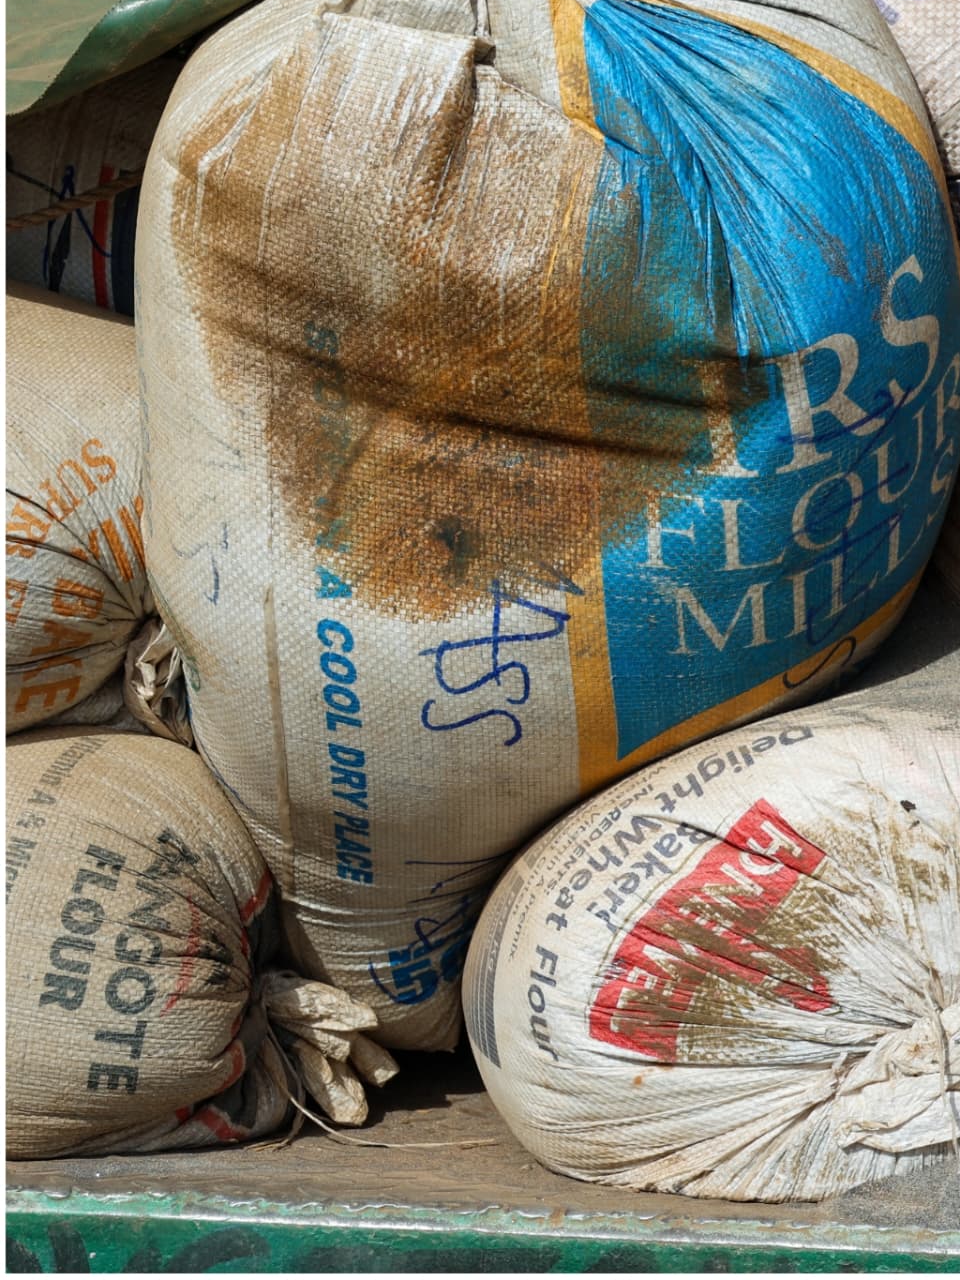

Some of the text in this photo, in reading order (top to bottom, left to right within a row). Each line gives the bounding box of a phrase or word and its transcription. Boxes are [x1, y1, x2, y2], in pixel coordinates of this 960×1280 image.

[315, 565, 352, 600] A
[316, 618, 363, 731] COOL
[27, 788, 57, 806] A
[328, 741, 369, 811] DRY
[333, 810, 375, 885] PLACE
[543, 783, 654, 896] INGREDIENTS:
[38, 842, 127, 1013] FLOUR
[527, 725, 815, 1062] Delight Wheat Flour
